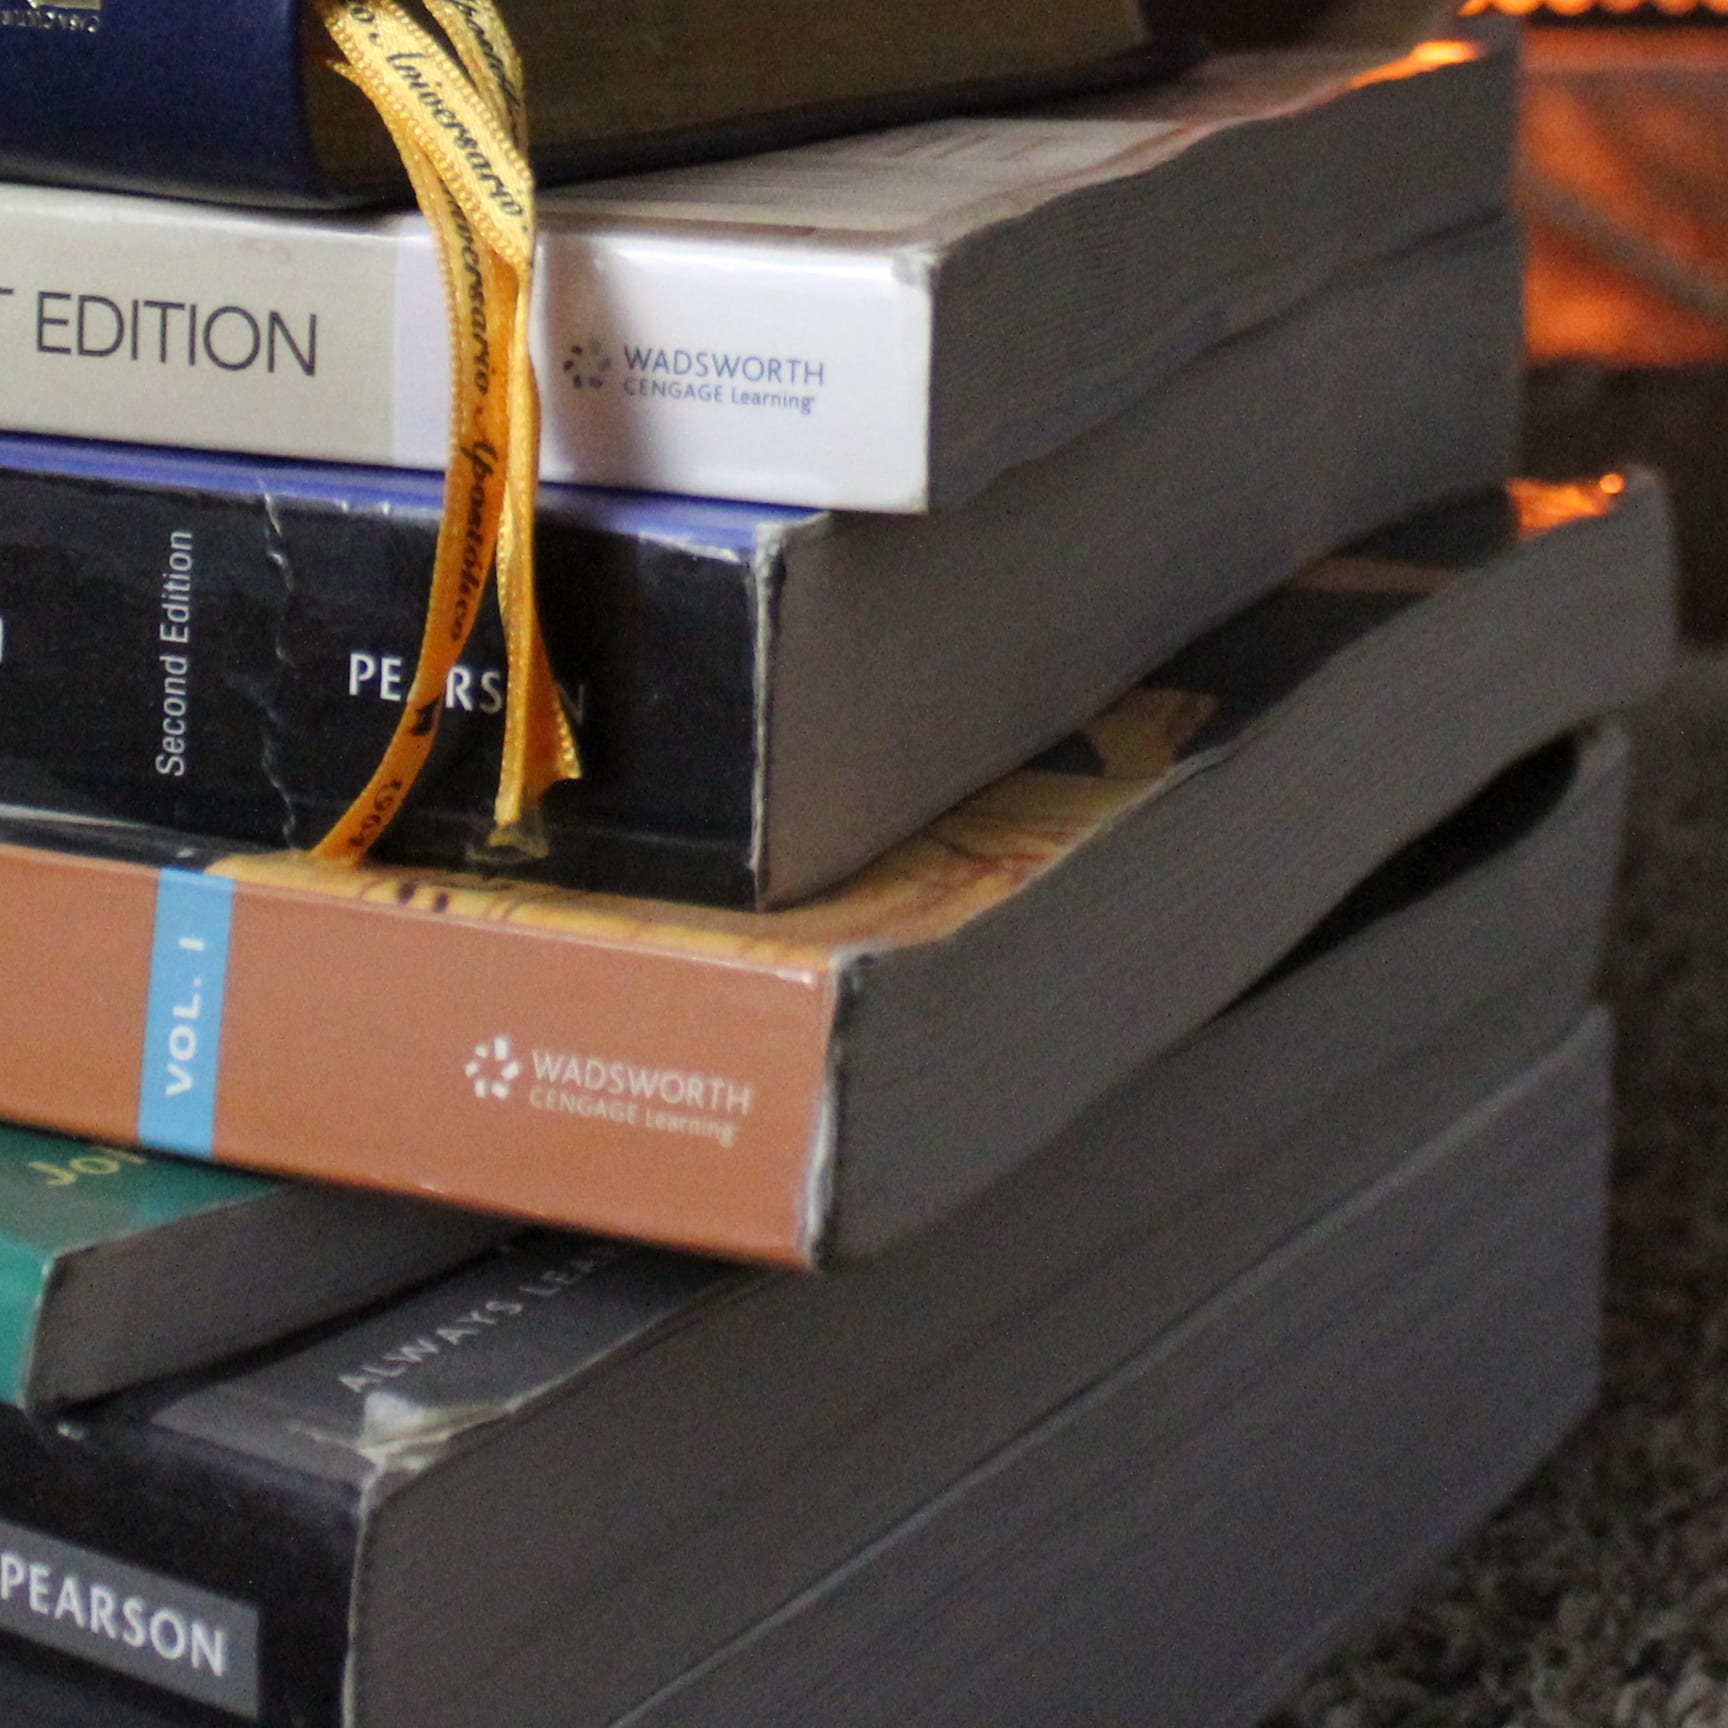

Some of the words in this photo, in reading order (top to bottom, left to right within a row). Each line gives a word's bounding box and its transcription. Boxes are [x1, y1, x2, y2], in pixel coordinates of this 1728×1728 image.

[36, 289, 318, 377] EDITION
[623, 344, 826, 389] WADSWORTH
[623, 378, 724, 405] CENGAGE
[730, 387, 815, 415] Learning
[159, 529, 194, 640] Edition
[155, 646, 189, 777] Second
[348, 652, 585, 728] PERSN
[163, 975, 205, 1097] VOL.
[529, 1086, 639, 1126] CENGAGE
[645, 1109, 738, 1147] Learning
[532, 1049, 753, 1113] WADSWORTH
[338, 1299, 523, 1394] ALWAYS
[0, 1550, 225, 1676] PEARSON
